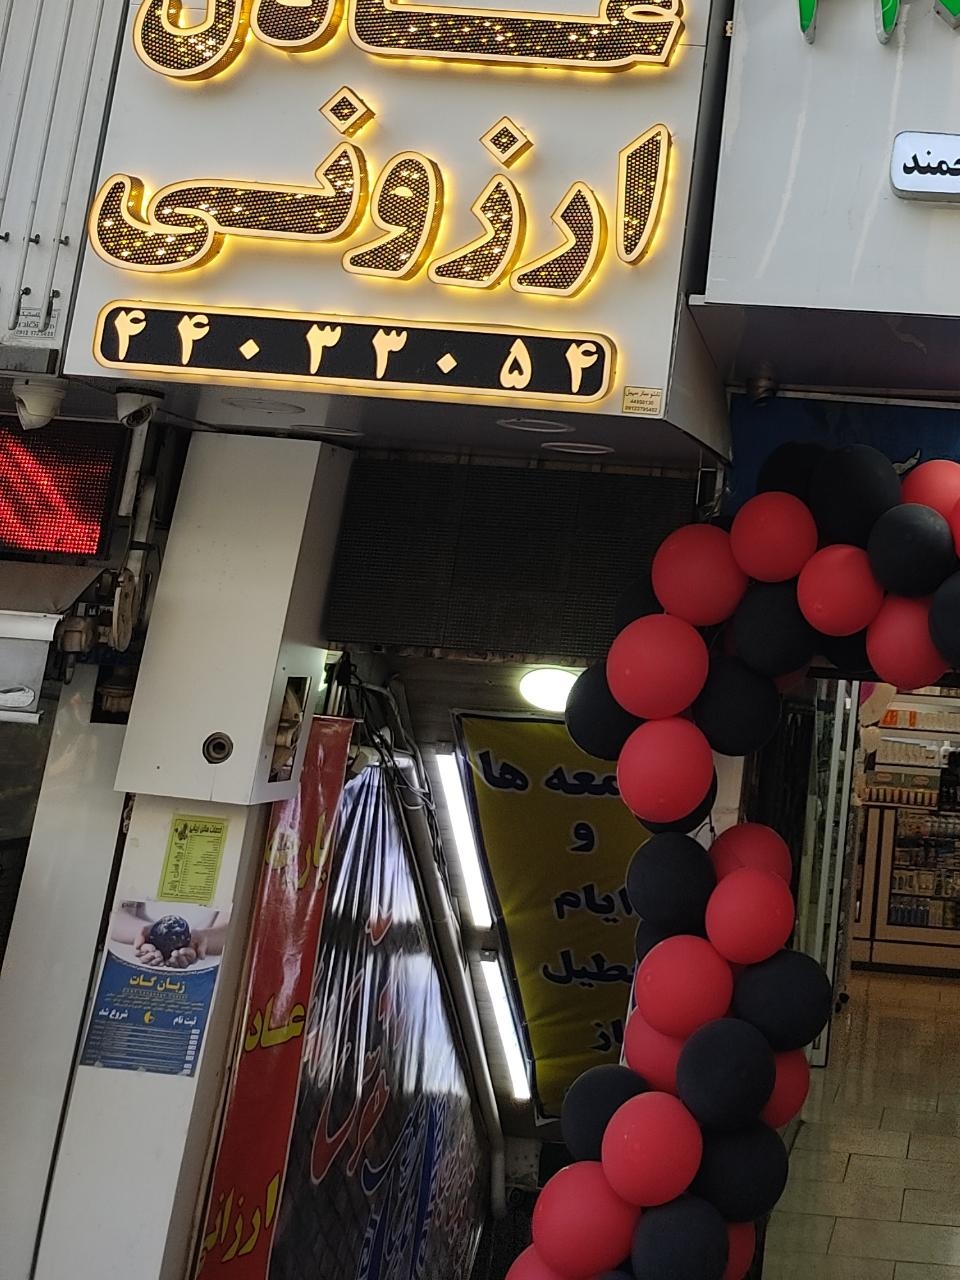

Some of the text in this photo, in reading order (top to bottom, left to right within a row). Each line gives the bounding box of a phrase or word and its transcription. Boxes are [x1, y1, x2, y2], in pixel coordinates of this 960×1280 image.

[89, 85, 672, 299] ارزونی
[114, 309, 599, 393] ۴۴۰۳۳۰۵۴
[478, 750, 621, 795] معه ها
[570, 822, 595, 852] و
[244, 993, 305, 1053] عاد
